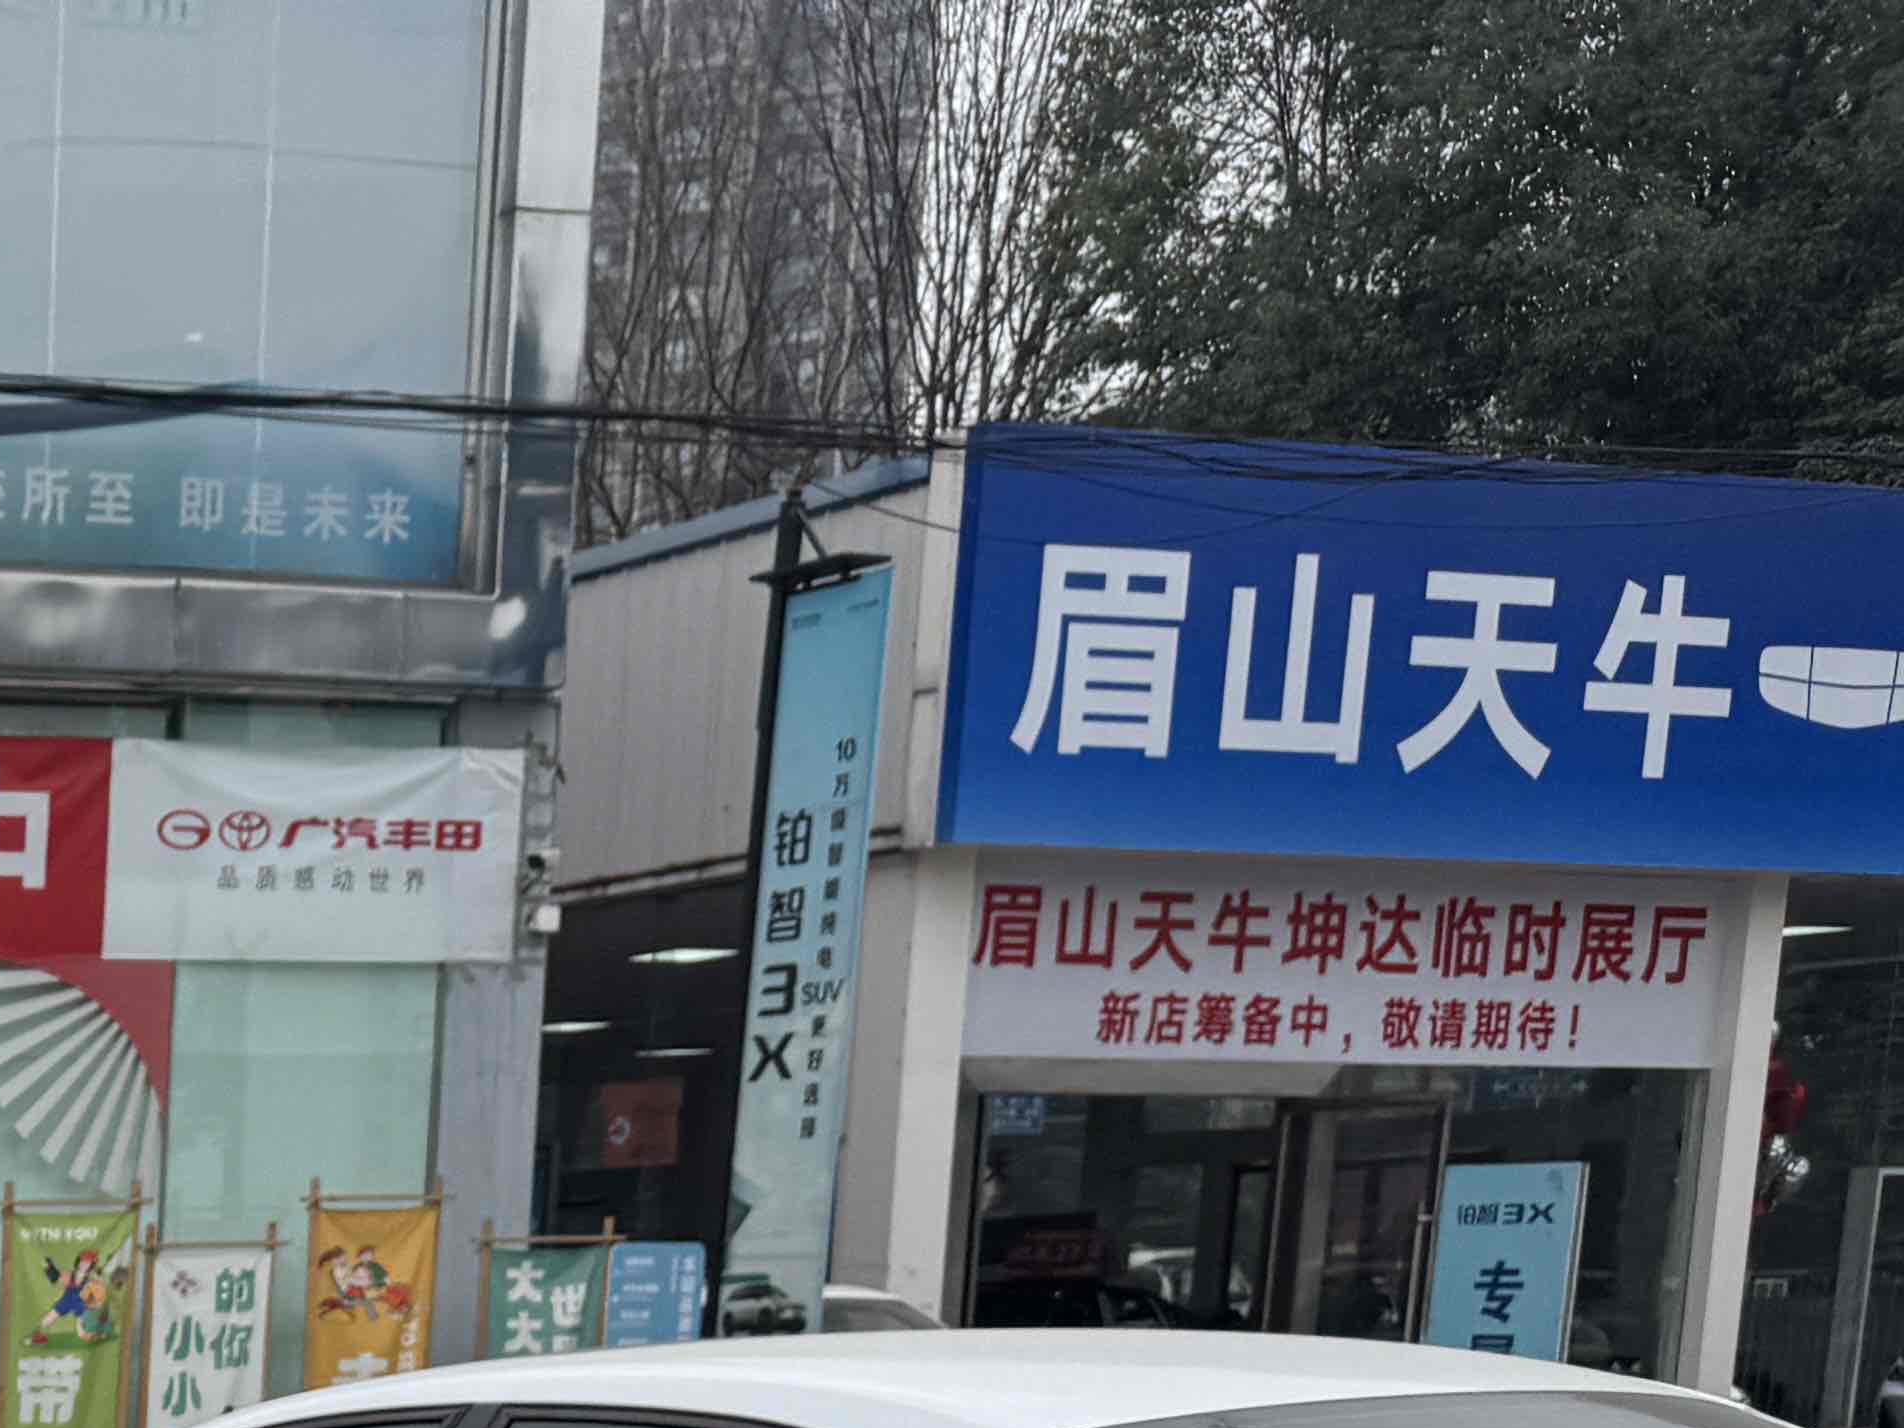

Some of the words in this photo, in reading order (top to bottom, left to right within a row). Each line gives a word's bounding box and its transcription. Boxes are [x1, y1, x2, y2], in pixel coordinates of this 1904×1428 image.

[179, 475, 412, 545] 即是未来
[1010, 543, 1732, 780] 眉山天牛
[217, 862, 427, 894] 品质感动世界
[277, 813, 483, 852] 广汽丰田
[748, 806, 814, 1083] 铂智3X
[972, 884, 1707, 986] 眉山天牛坤达临时展厅
[210, 1267, 256, 1369] 的你
[504, 1259, 545, 1353] 大大
[162, 1316, 205, 1416] 小小
